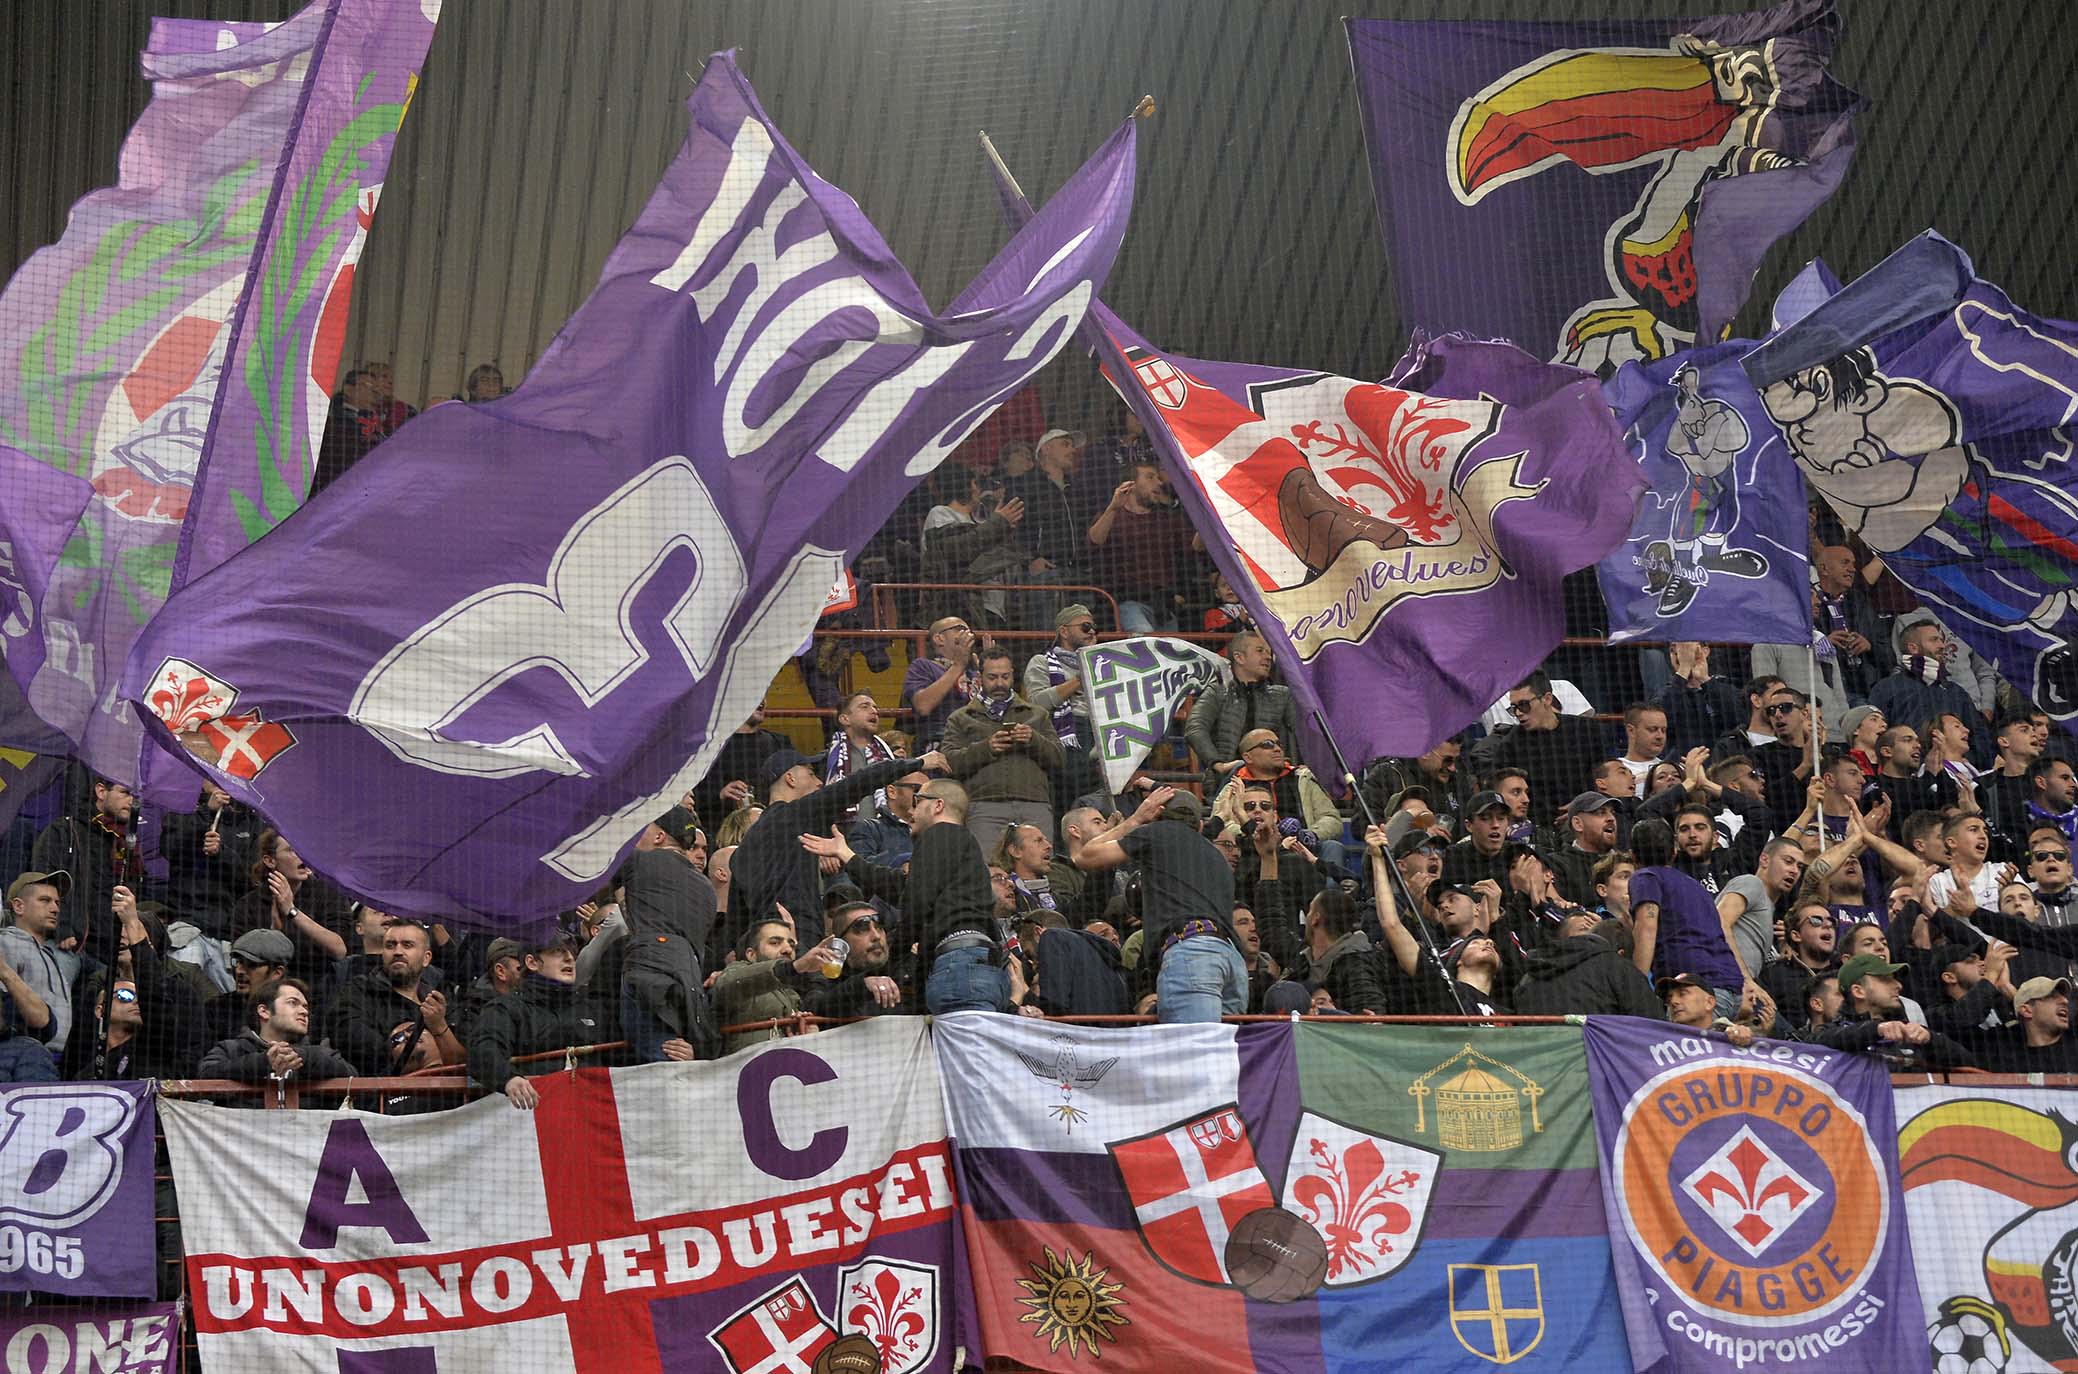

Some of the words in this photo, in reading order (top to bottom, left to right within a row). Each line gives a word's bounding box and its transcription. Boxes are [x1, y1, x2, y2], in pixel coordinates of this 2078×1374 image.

[1658, 1073, 1832, 1137] GRUPPO
[300, 1118, 430, 1250] A
[737, 1048, 849, 1181] C
[202, 1154, 954, 1326] UNONOVEDUESEI
[1662, 1235, 1854, 1311] PIAGGE
[6, 1315, 170, 1374] ONE
[1667, 1289, 1886, 1369] compromessi
